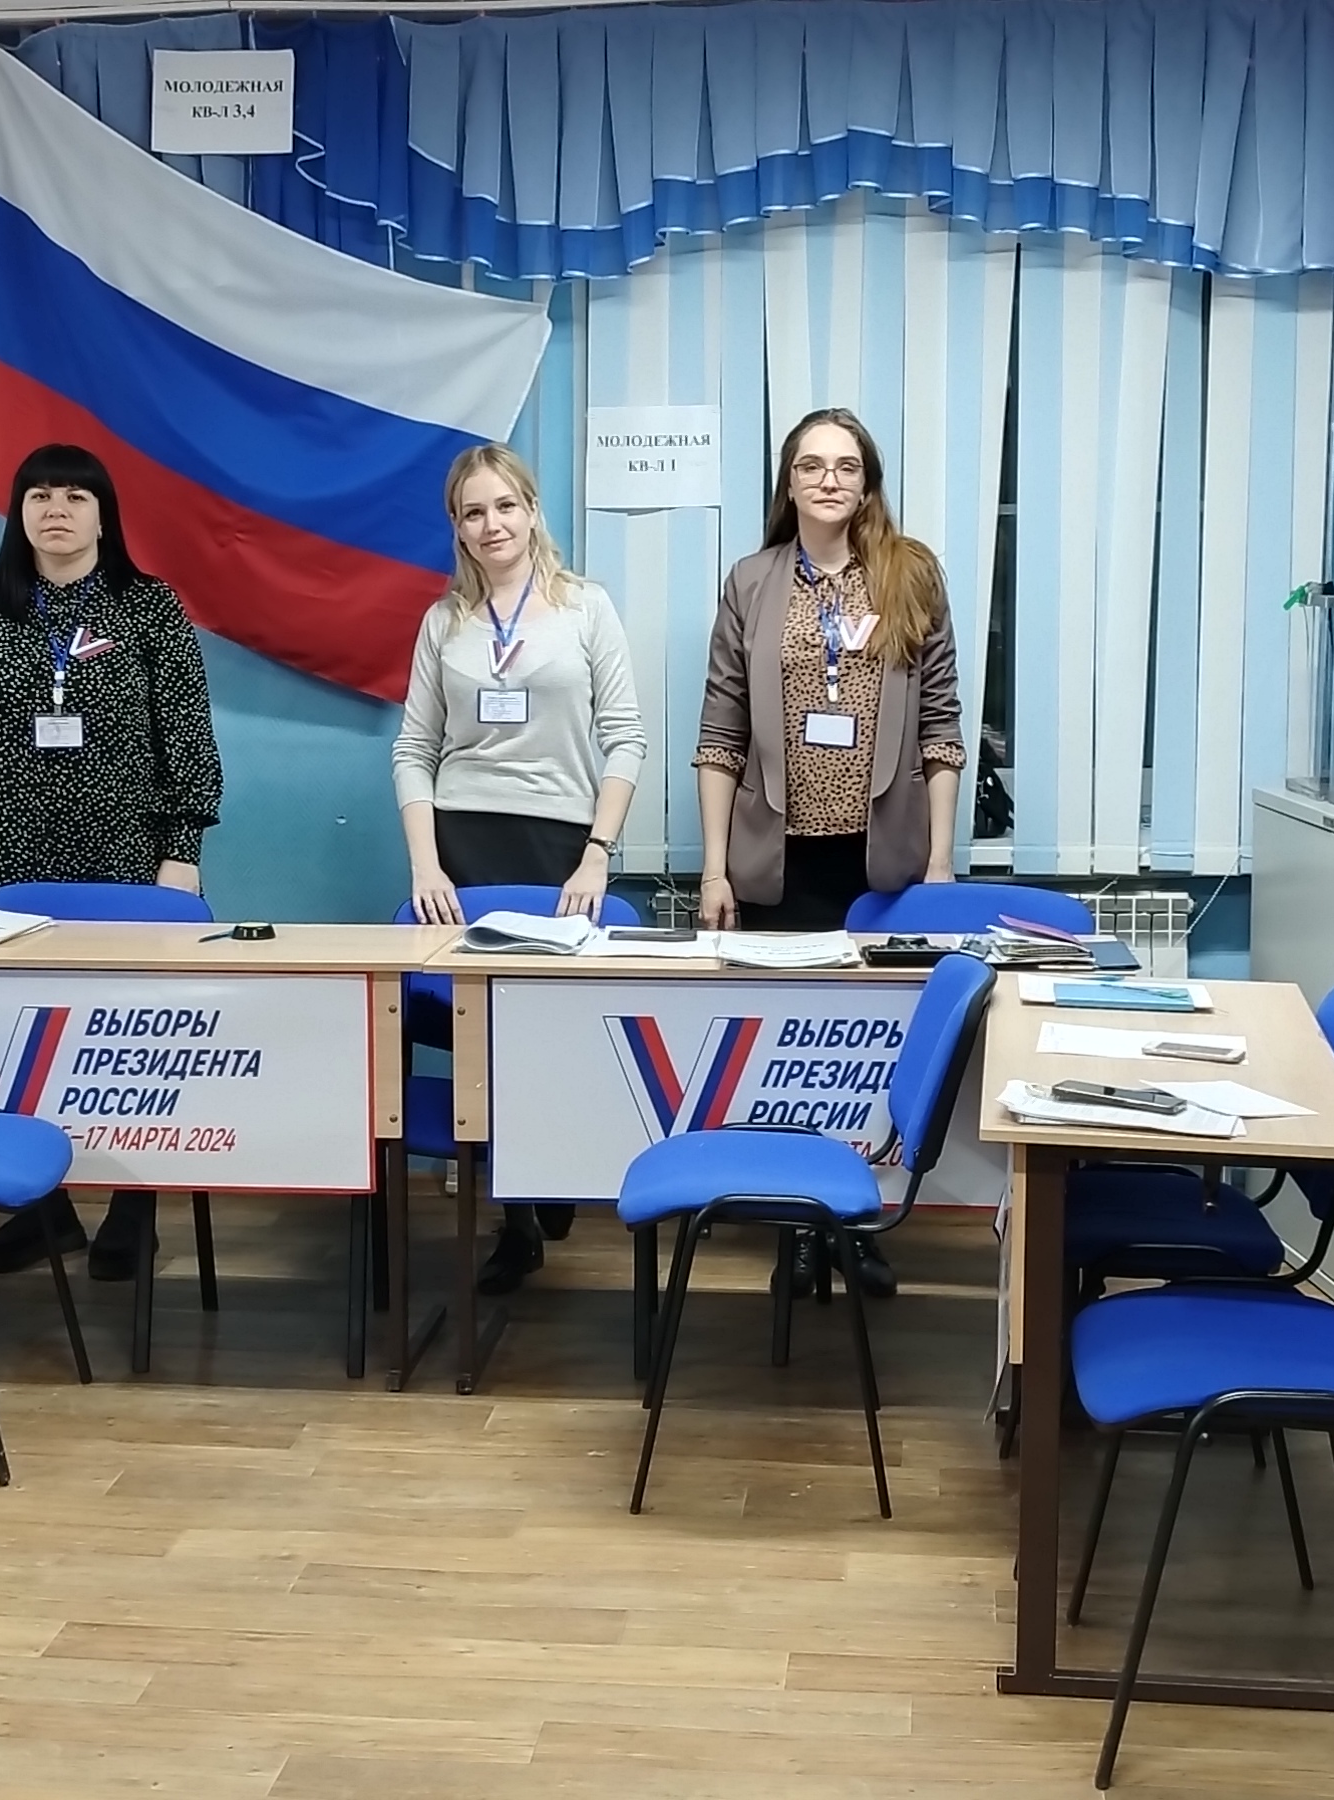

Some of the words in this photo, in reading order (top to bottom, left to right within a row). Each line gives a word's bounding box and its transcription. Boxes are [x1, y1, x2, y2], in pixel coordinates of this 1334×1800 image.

[164, 79, 284, 95] МОЛОДЕЖНАЯ
[192, 105, 229, 119] КВ-Л
[232, 104, 256, 120] 3,4
[596, 433, 711, 448] МОЛОДЕЖНАЯ
[627, 459, 665, 472] КВ-Л
[84, 1007, 221, 1037] ВЫБОРЫ
[72, 1047, 261, 1081] ПРЕЗИДЕНТА
[761, 1059, 897, 1094] ПРЕЗИД
[58, 1086, 181, 1116] РОССИИ
[748, 1100, 872, 1130] РОССИИ
[108, 1126, 181, 1151] МАРТА
[184, 1127, 237, 1152] 2024
